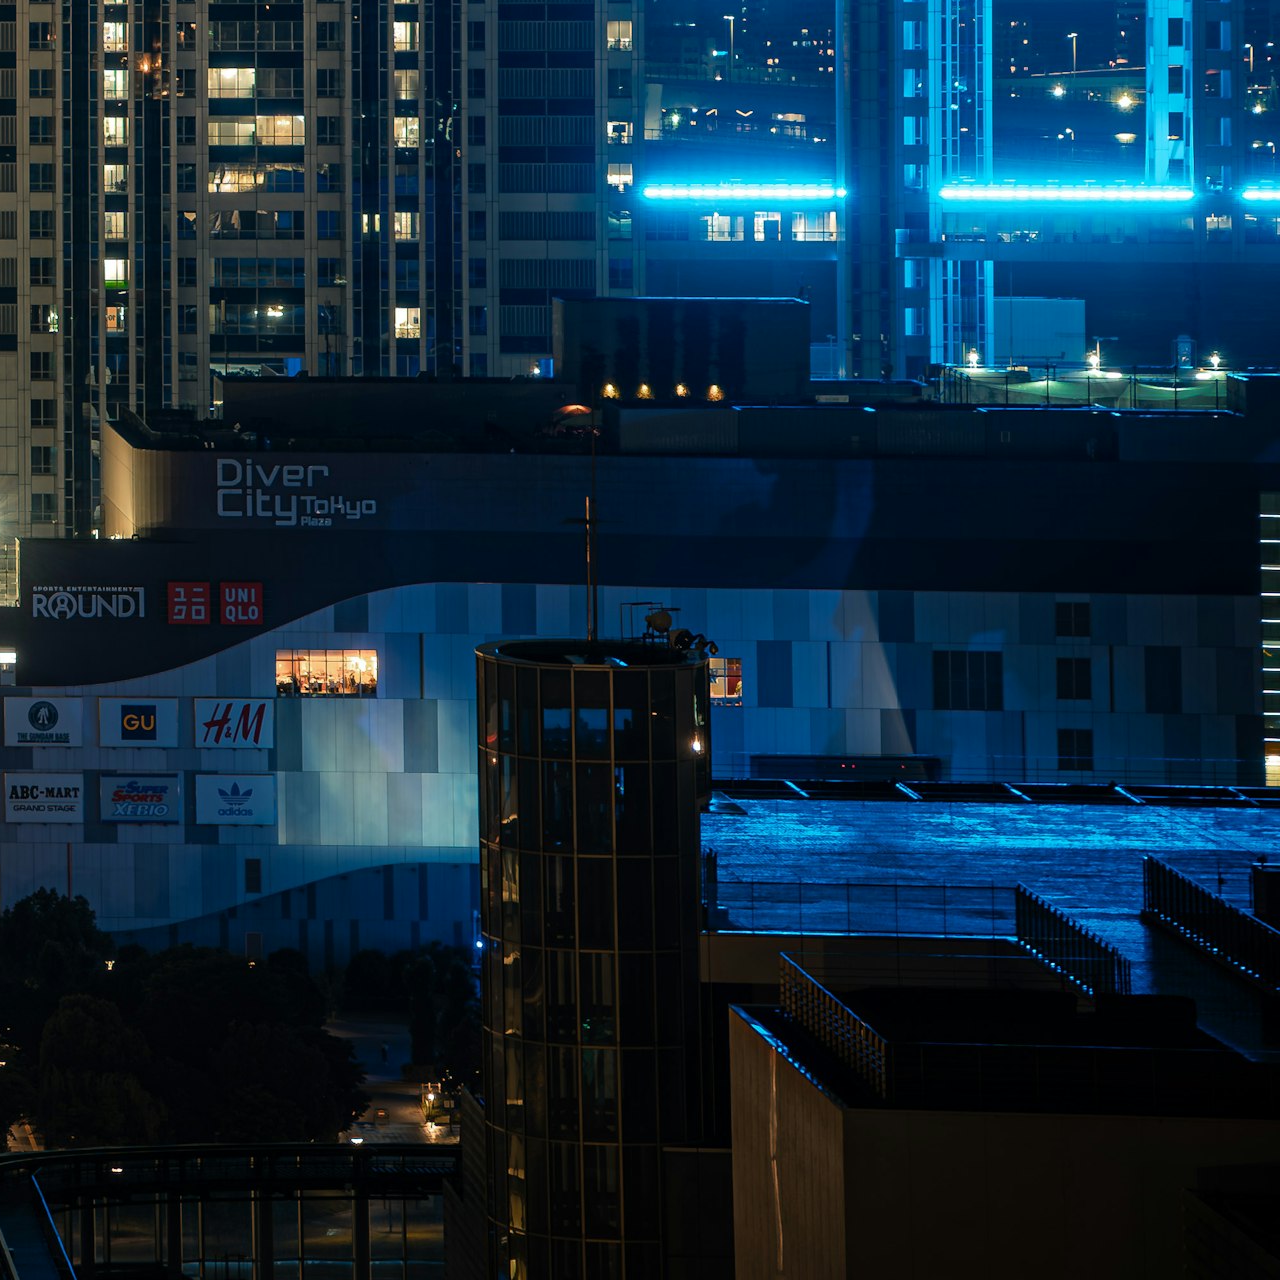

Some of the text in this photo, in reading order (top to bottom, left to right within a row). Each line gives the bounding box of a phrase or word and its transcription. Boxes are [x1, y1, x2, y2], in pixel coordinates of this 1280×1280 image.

[216, 458, 329, 487] Diver
[216, 488, 377, 526] City Tokyo
[300, 515, 333, 527] Plaza
[225, 588, 256, 603] UNI
[32, 587, 145, 620] ROUND1
[225, 605, 259, 622] QLO
[123, 713, 155, 731] GU
[203, 703, 266, 745] H&M
[17, 732, 70, 740] THE GUNDAM BASE
[9, 785, 80, 800] ABC-MART
[125, 780, 169, 794] SUPER
[111, 789, 164, 802] SPORTS
[13, 804, 77, 812] GRAND STAGE
[111, 802, 169, 817] XEBIO
[217, 807, 254, 816] adidas
